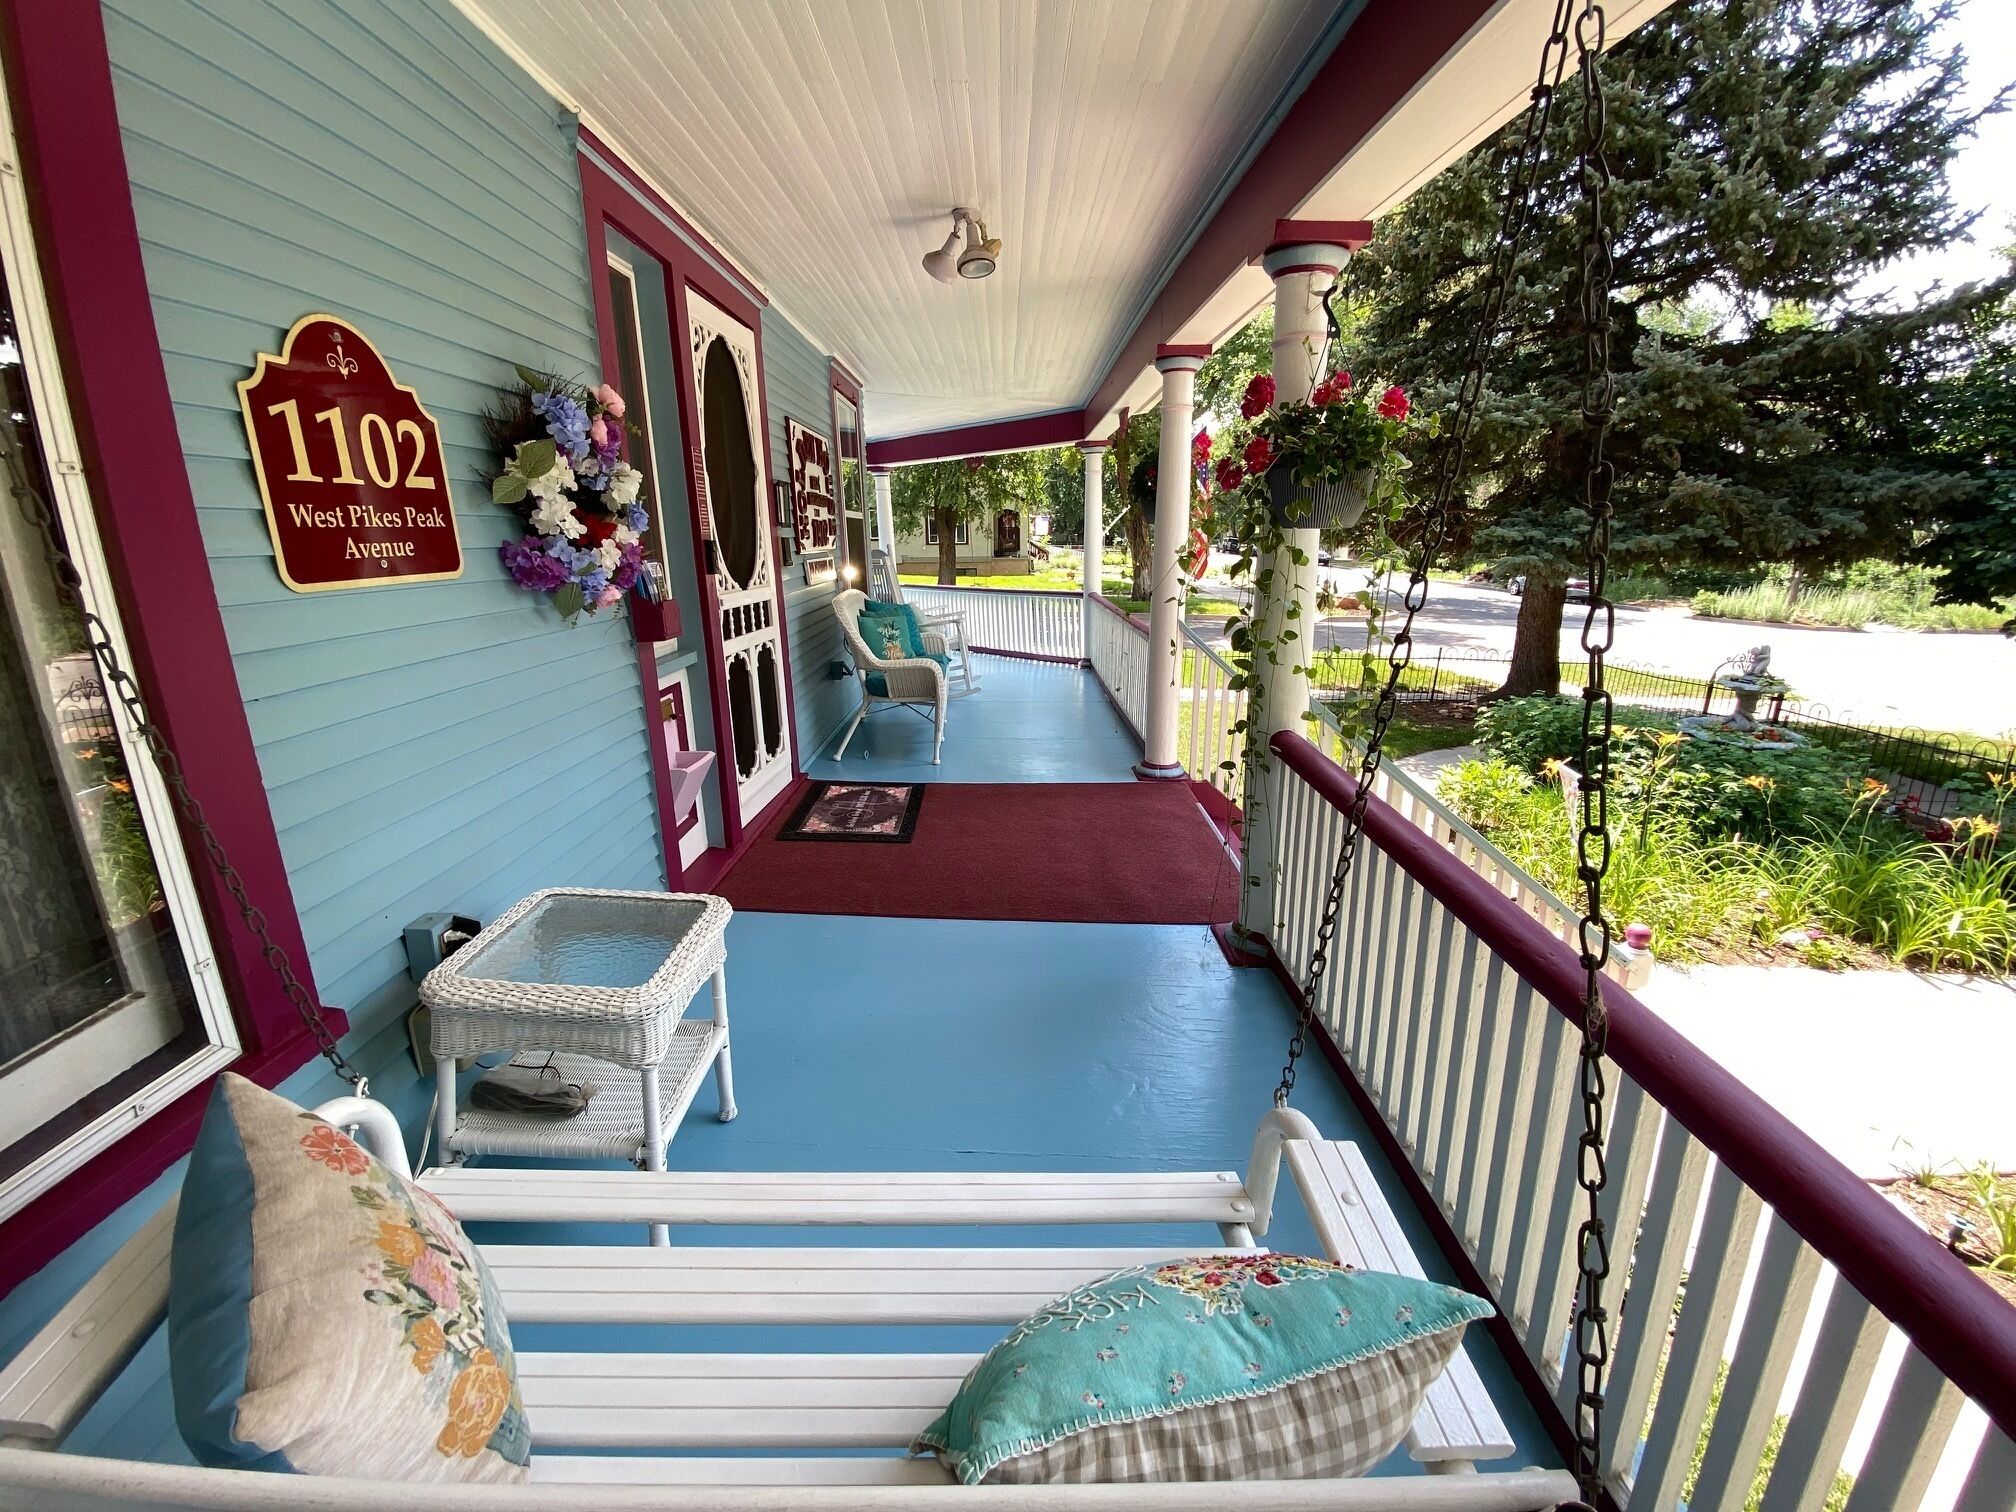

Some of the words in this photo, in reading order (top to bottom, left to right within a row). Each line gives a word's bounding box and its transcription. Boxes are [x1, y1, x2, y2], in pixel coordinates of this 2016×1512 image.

[267, 398, 436, 490] 1102
[287, 503, 346, 528] West
[346, 505, 402, 528] Pikes
[404, 506, 446, 528] Peak
[344, 536, 415, 559] Avenue
[1059, 1284, 1161, 1331] KICK
